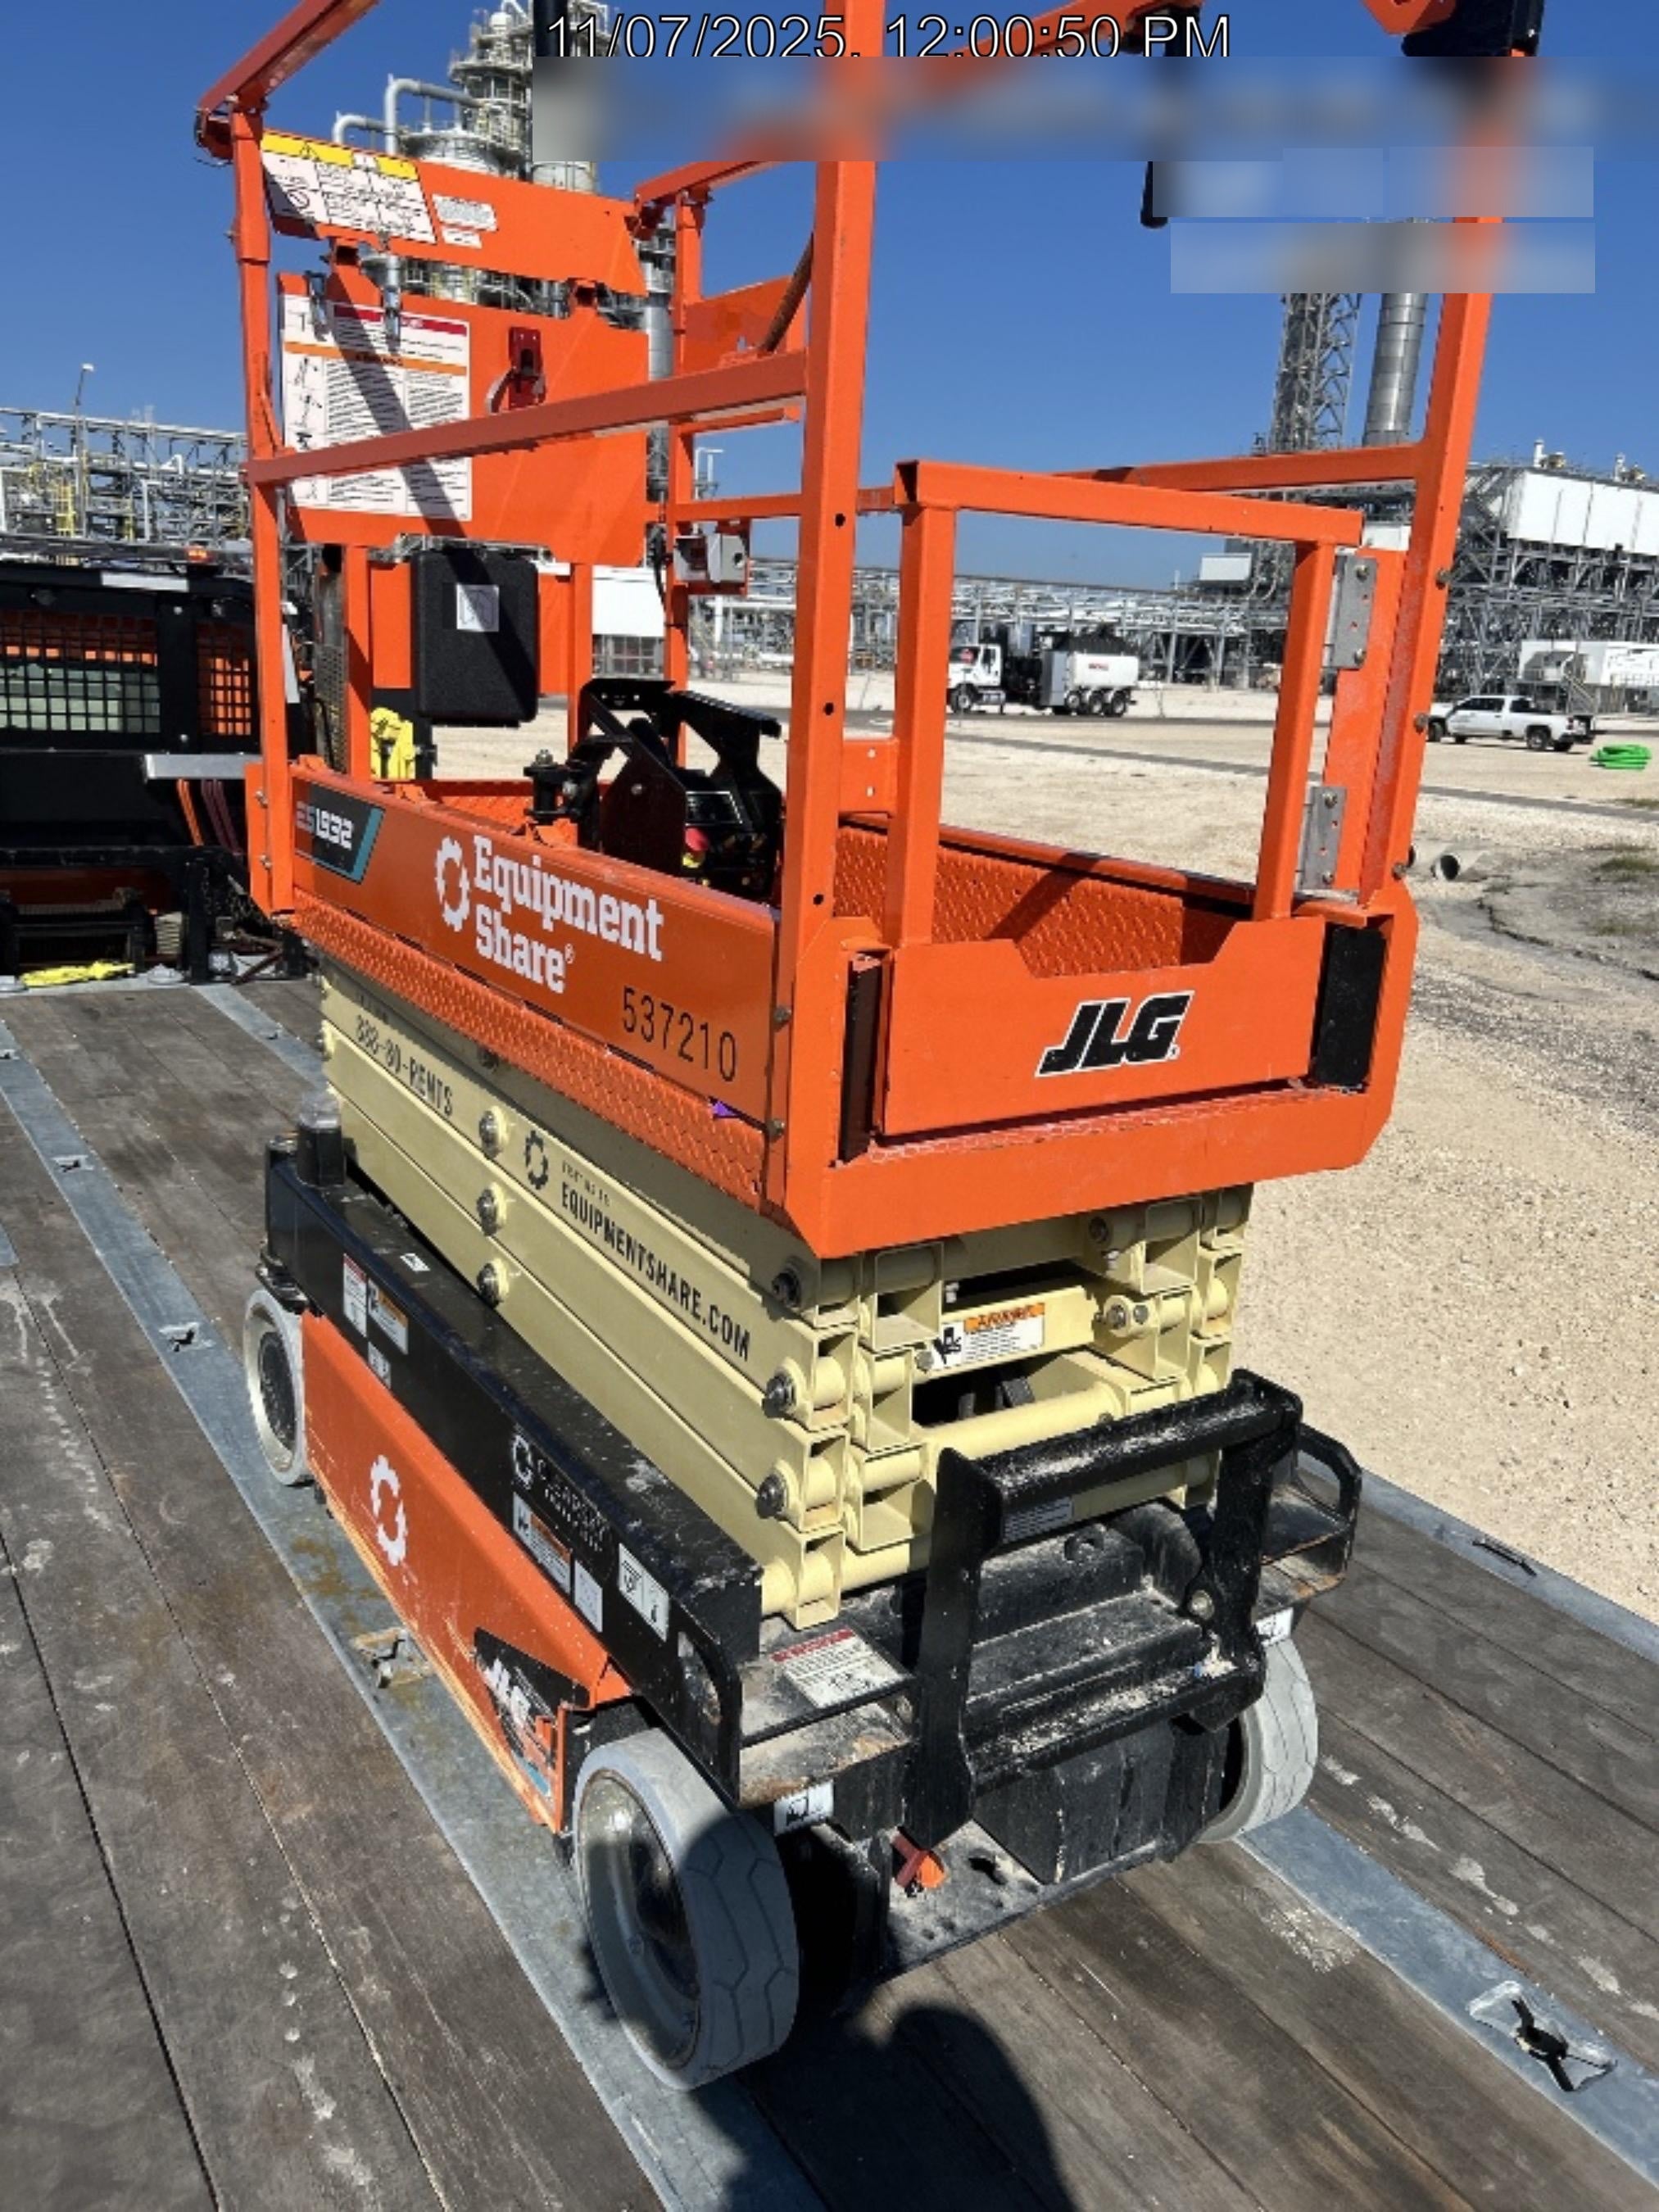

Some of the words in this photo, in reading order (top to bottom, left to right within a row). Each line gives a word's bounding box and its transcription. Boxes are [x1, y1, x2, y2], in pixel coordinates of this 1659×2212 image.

[473, 834, 664, 962] Equipment
[622, 986, 737, 1082] 537210
[1035, 990, 1195, 1077] JLG
[562, 1181, 750, 1362] EQUIPMENTSHARE.COM
